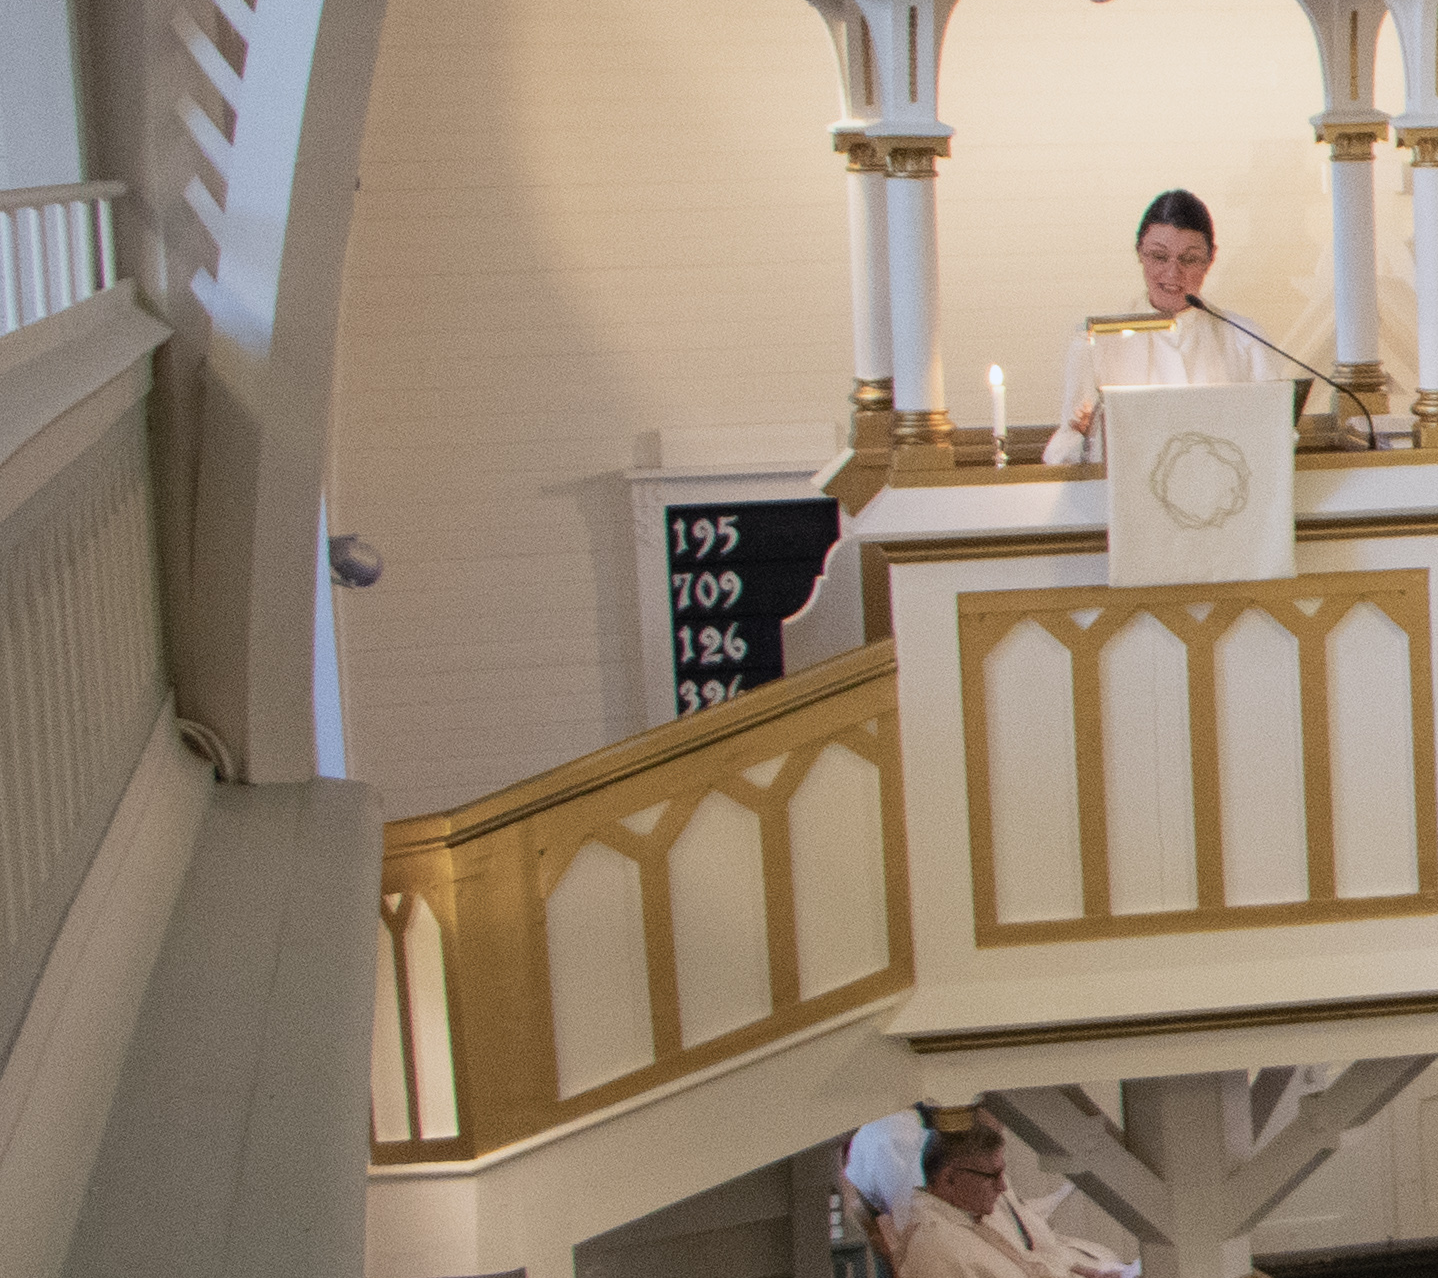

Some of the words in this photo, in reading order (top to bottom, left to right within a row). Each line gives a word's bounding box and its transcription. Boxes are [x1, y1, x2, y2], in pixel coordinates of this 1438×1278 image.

[673, 515, 740, 559] 195
[672, 571, 743, 610] 709
[679, 622, 747, 664] 126
